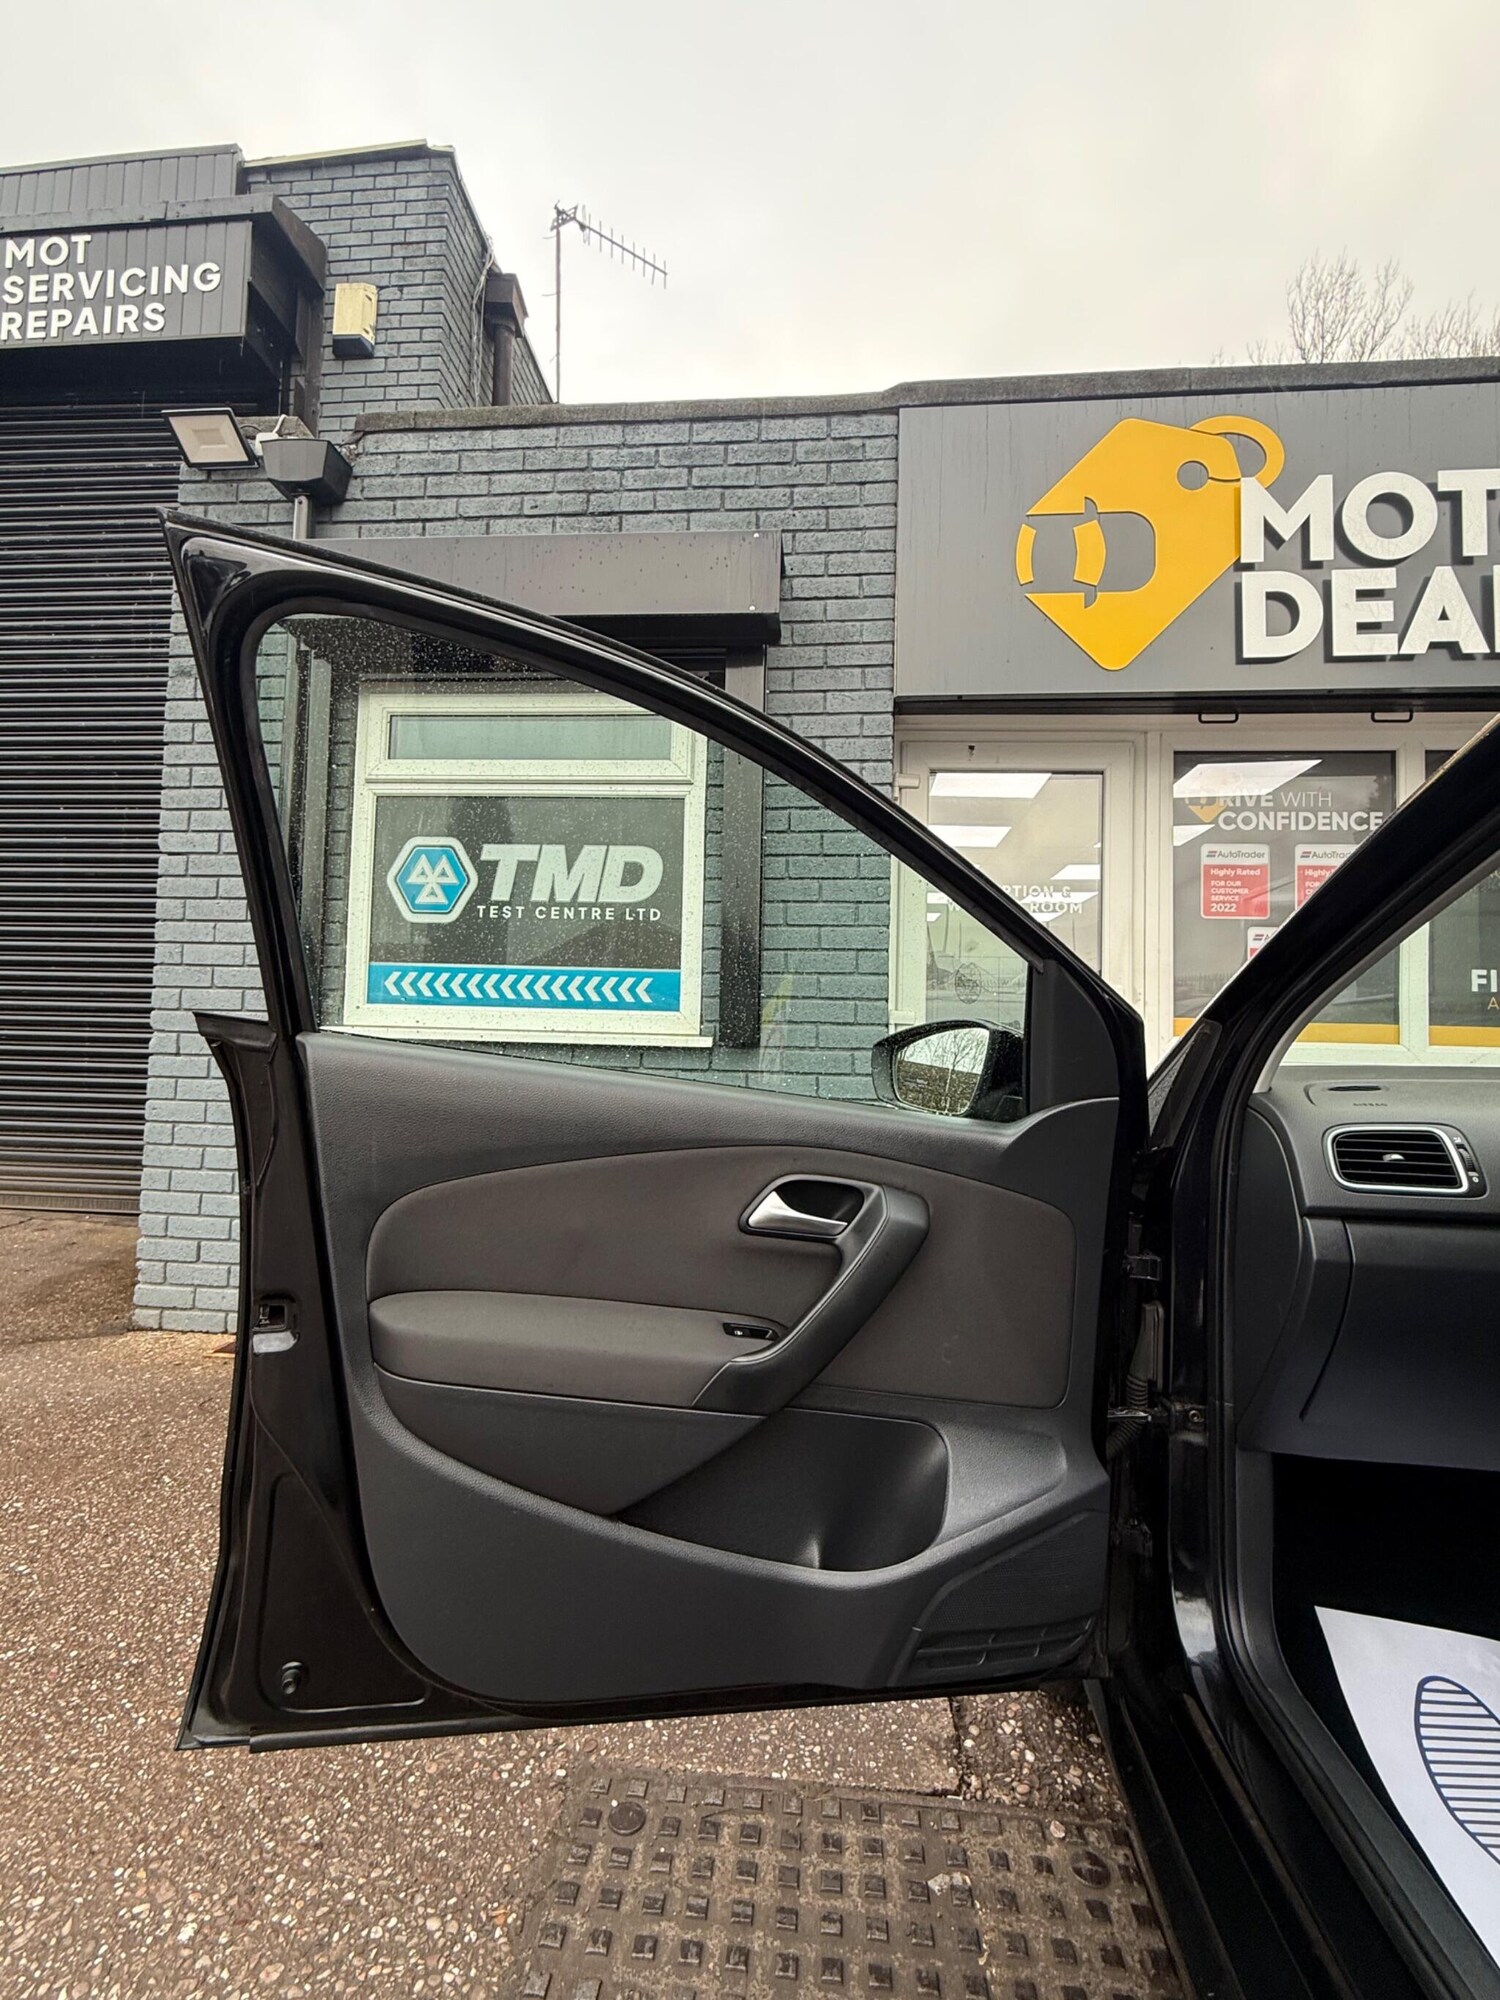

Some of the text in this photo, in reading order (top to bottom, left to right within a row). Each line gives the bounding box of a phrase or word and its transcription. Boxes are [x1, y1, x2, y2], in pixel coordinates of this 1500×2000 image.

[5, 234, 92, 269] MOT
[2, 262, 222, 304] SERVICING
[1, 302, 166, 341] REPAIRS
[1281, 791, 1332, 807] WITH
[1218, 811, 1384, 831] CONFIDENCE
[1217, 850, 1266, 858] AutoTrader
[480, 843, 664, 903] TMD
[1210, 868, 1261, 877] Highly Rated
[1061, 886, 1072, 898] &
[1211, 887, 1249, 895] CUSTOMER
[1211, 894, 1240, 902] SERVICE
[477, 905, 661, 921] TEST CENTRE LTD
[1030, 901, 1082, 914] ROOM
[1210, 902, 1237, 912] 2022
